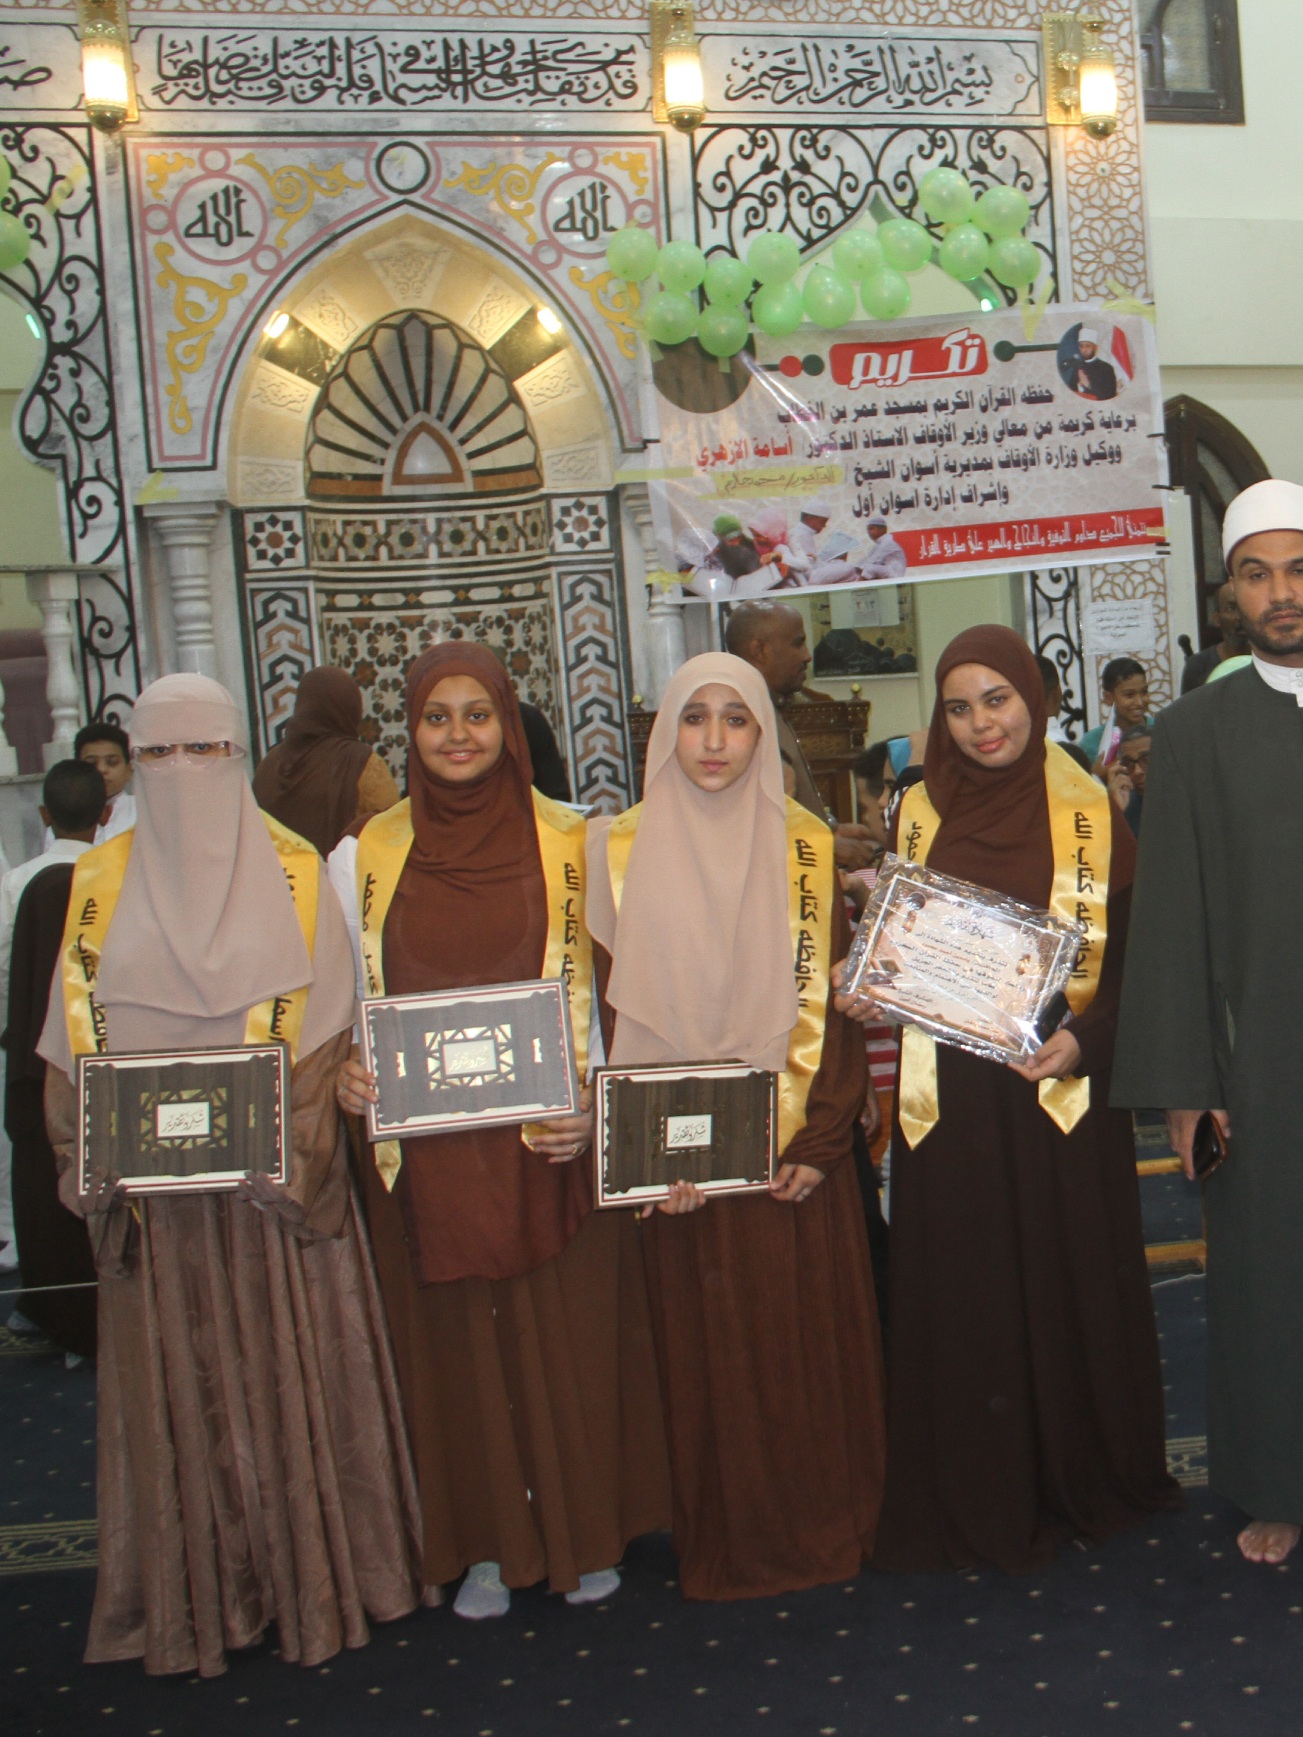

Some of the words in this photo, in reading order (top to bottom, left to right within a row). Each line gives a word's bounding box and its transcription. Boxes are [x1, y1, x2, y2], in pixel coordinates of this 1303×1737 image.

[725, 42, 828, 105] الرحيم
[806, 44, 905, 108] الرحمن
[919, 52, 994, 107] بسم
[849, 328, 980, 389] تكريم
[934, 389, 974, 417] الكريم
[979, 385, 1016, 413] القرآن
[1021, 384, 1054, 404] حفظه
[831, 404, 847, 424] بن
[852, 402, 878, 423] عمر
[884, 400, 927, 419] بمسجد
[1099, 410, 1137, 433] برعاية
[962, 422, 988, 445] وزير
[993, 419, 1027, 447] معالي
[1034, 420, 1052, 439] من
[1058, 411, 1094, 437] كريمة
[753, 430, 793, 457] أسامة
[1082, 440, 1122, 465] ووكيل
[944, 454, 993, 477] بمديرية
[1045, 447, 1078, 470] وزارة
[1074, 812, 1093, 839] الله
[795, 839, 817, 867] الله
[564, 863, 580, 890] الله
[1071, 847, 1094, 894] كتاب
[80, 898, 98, 925] الله
[363, 873, 376, 931] محمد
[794, 874, 818, 923] كتاب
[561, 898, 578, 945] كتاب
[73, 933, 97, 982] كتاب
